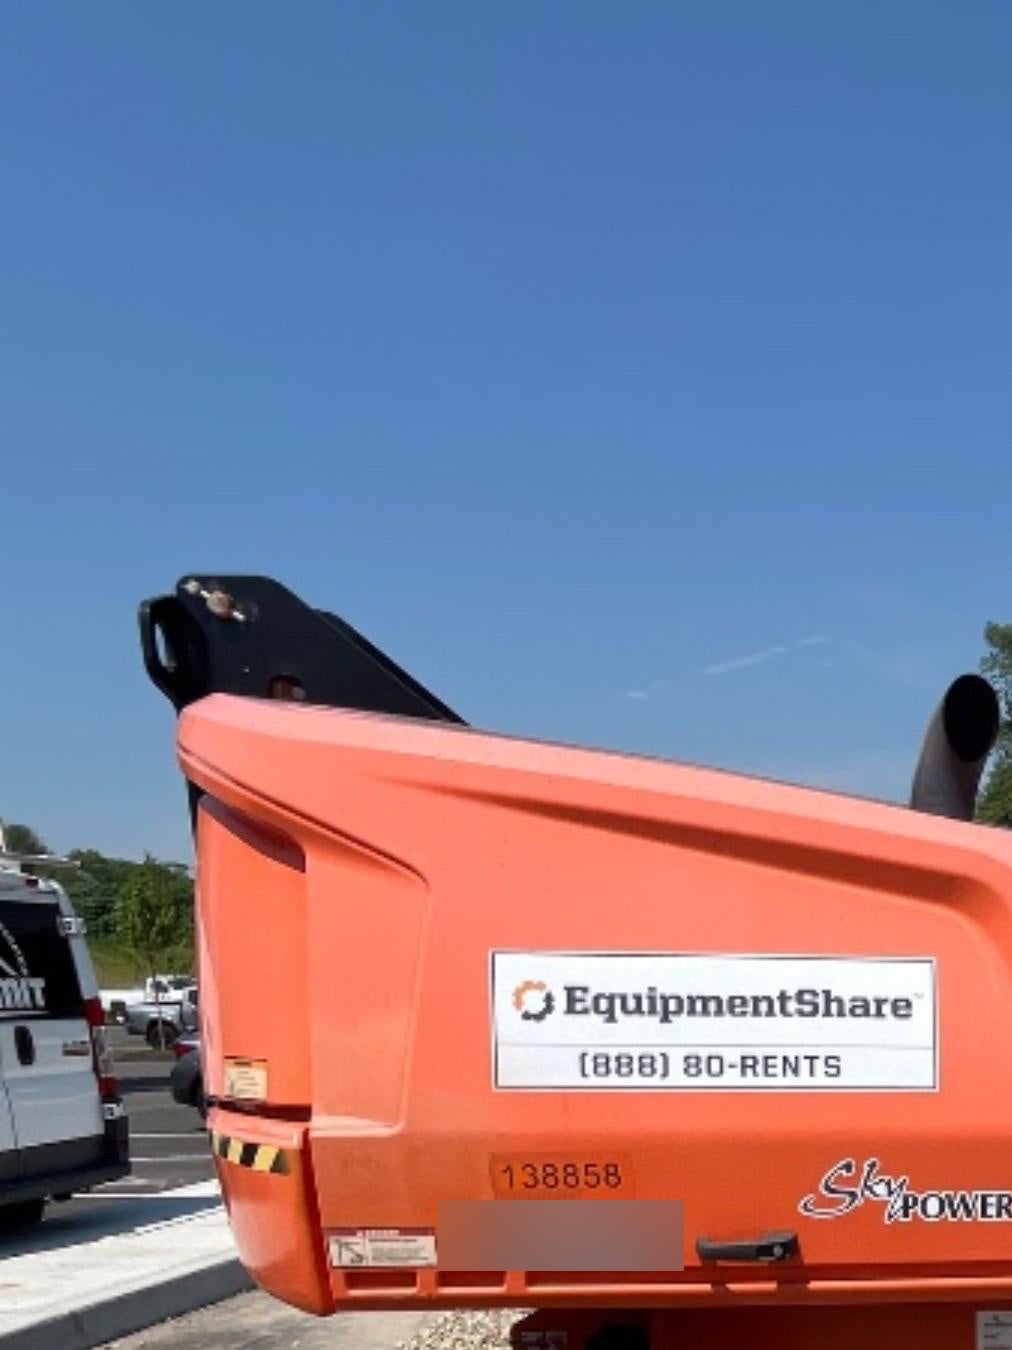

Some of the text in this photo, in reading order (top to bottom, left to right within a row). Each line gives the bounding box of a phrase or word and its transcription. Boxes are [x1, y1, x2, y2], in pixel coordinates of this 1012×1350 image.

[563, 986, 913, 1023] EquipmentShare
[683, 1054, 842, 1079] 80-RENTS
[501, 1163, 622, 1189] 138858
[799, 1158, 908, 1224] Sky
